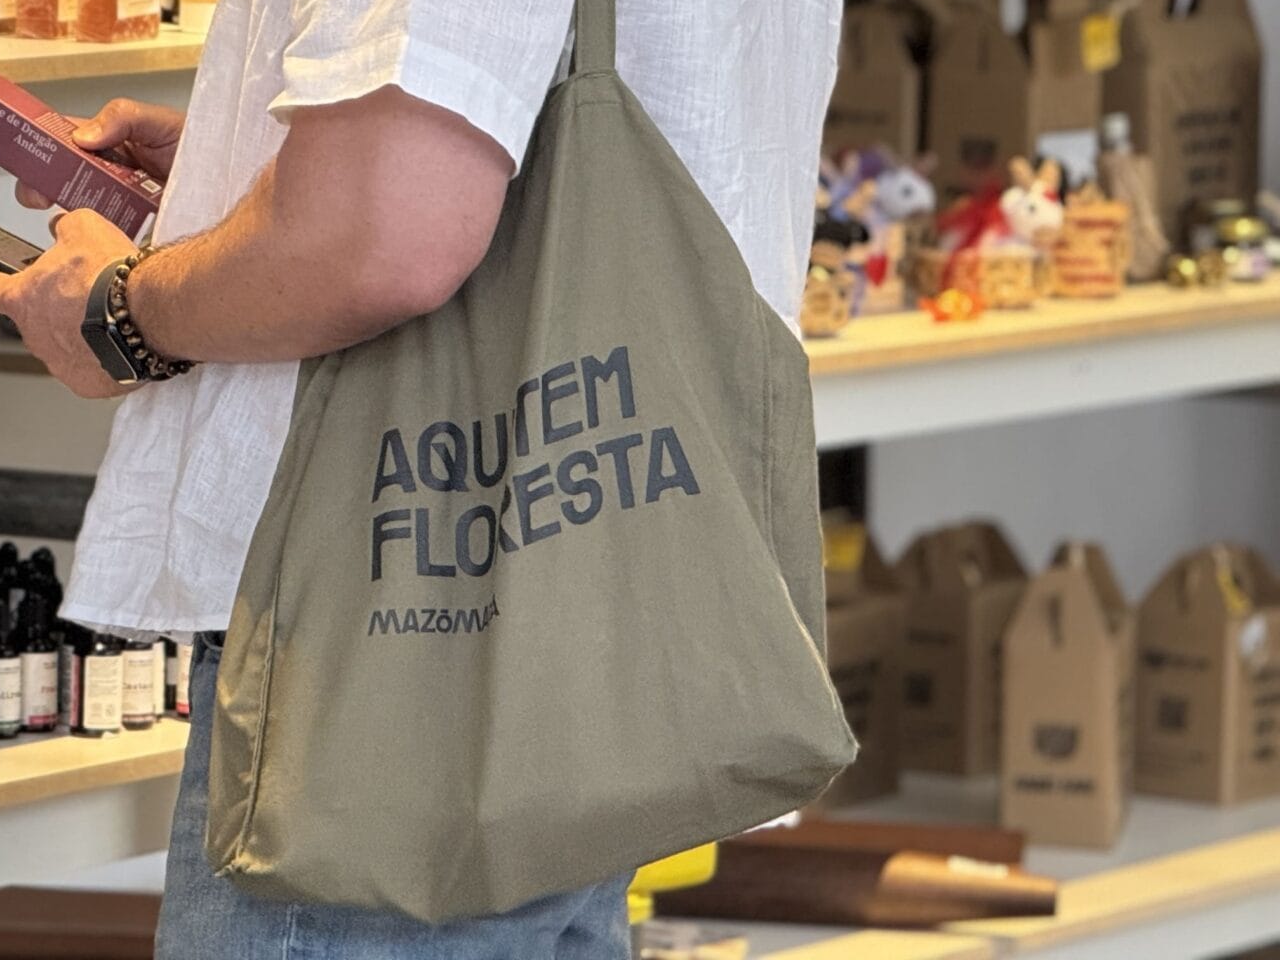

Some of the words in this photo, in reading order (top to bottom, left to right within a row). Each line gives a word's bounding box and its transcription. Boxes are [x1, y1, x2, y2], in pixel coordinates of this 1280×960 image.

[6, 114, 20, 127] de
[20, 122, 58, 152] Dragão
[13, 134, 53, 164] Antioxi
[514, 346, 636, 458] TEM
